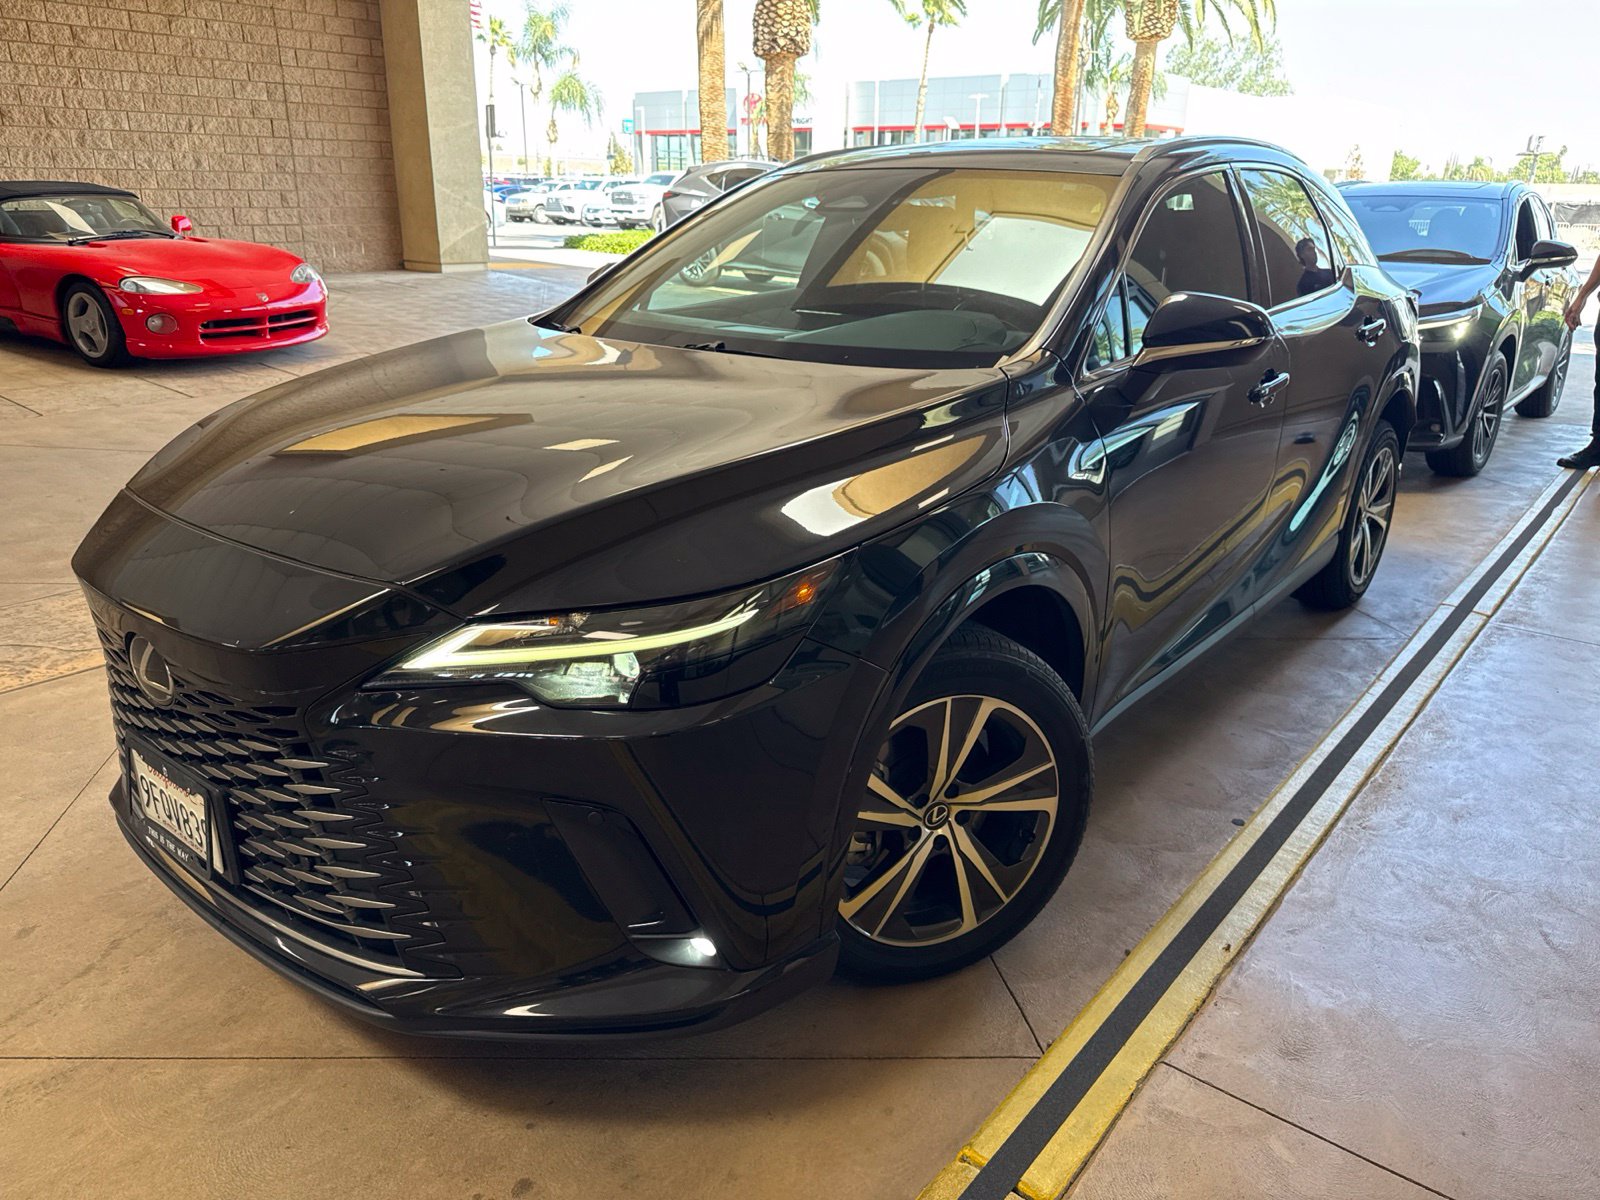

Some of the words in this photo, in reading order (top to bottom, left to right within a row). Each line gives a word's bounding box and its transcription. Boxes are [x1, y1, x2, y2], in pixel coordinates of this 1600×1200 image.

[147, 825, 159, 839] THIS
[165, 839, 176, 852] THE
[176, 847, 189, 862] WAY
